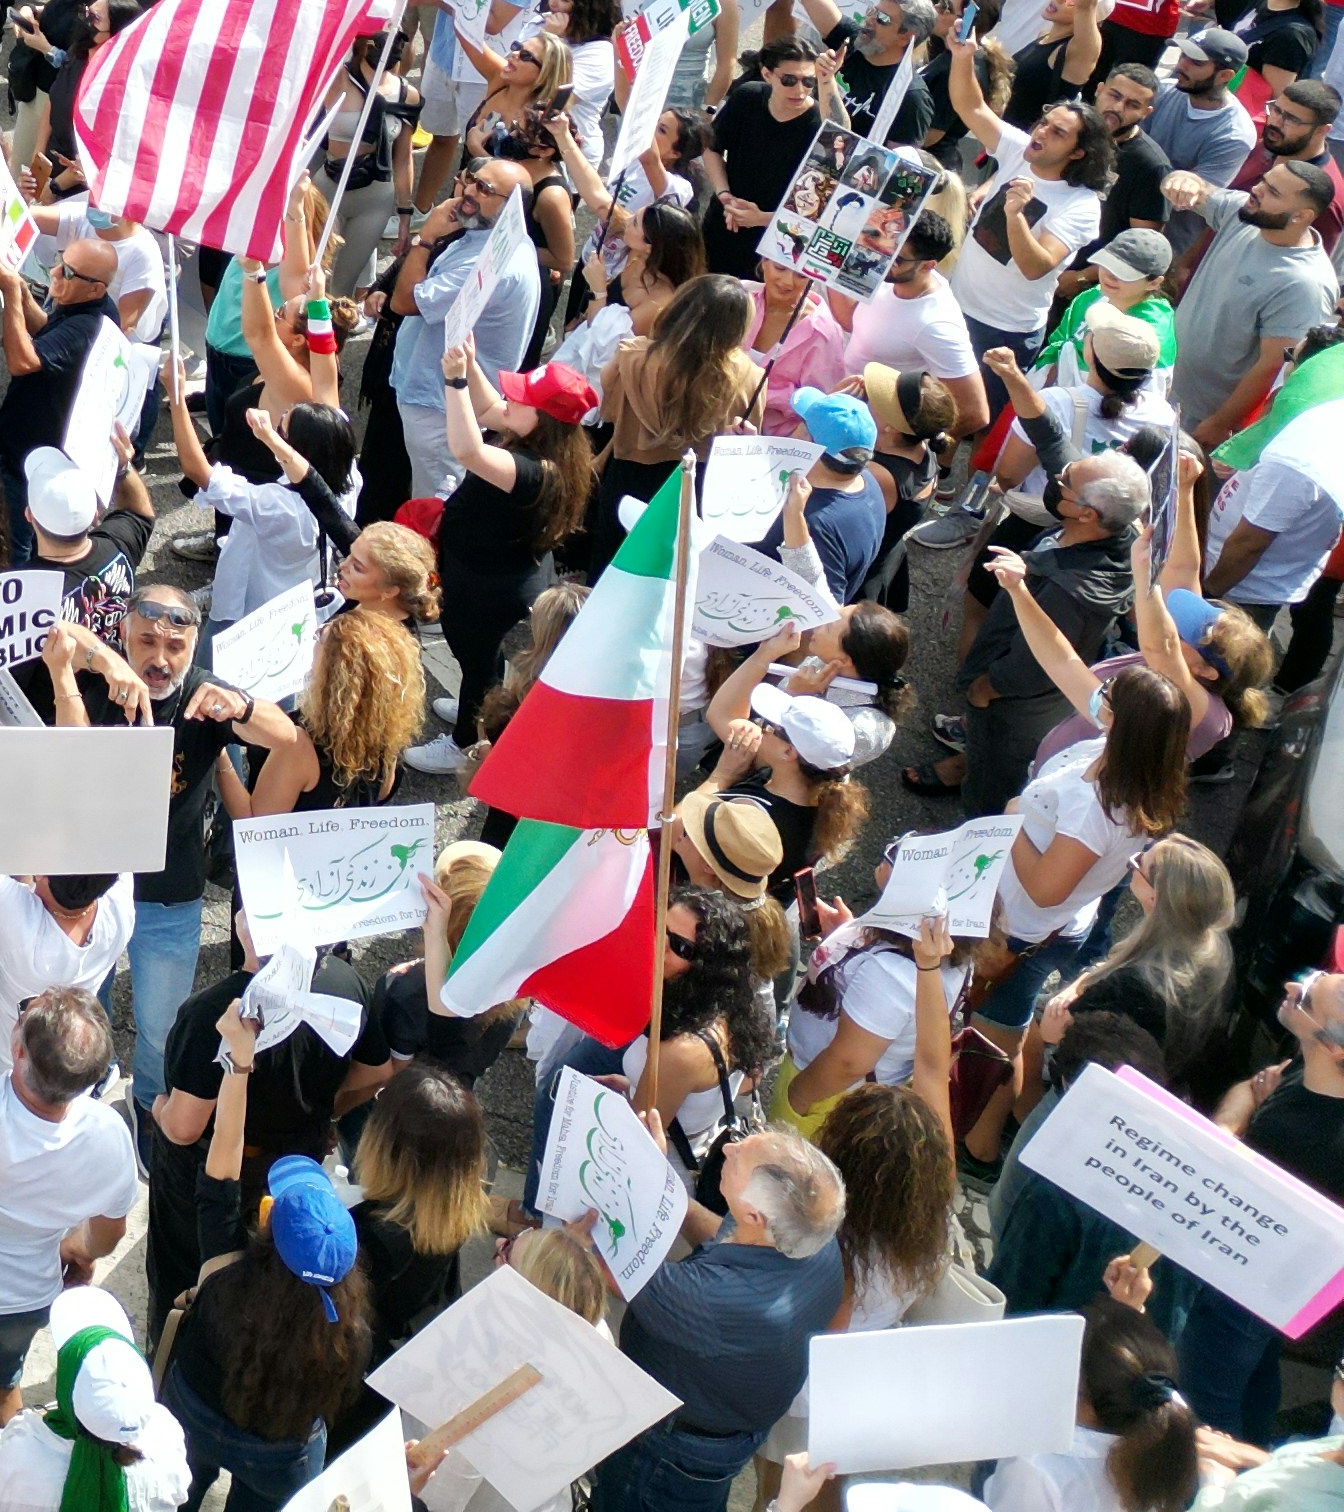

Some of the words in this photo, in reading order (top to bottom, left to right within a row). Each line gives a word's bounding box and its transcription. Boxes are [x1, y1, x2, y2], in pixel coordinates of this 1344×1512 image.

[349, 814, 432, 833] Freedom.
[1082, 1156, 1167, 1214] people
[1171, 1209, 1200, 1231] of
[1195, 1226, 1250, 1268] Iran
[1104, 1138, 1127, 1158] in
[1130, 1150, 1186, 1193] Iran
[1183, 1186, 1215, 1219] by
[1219, 1208, 1262, 1247] the
[1108, 1115, 1201, 1177] Regime
[1200, 1166, 1290, 1238] change
